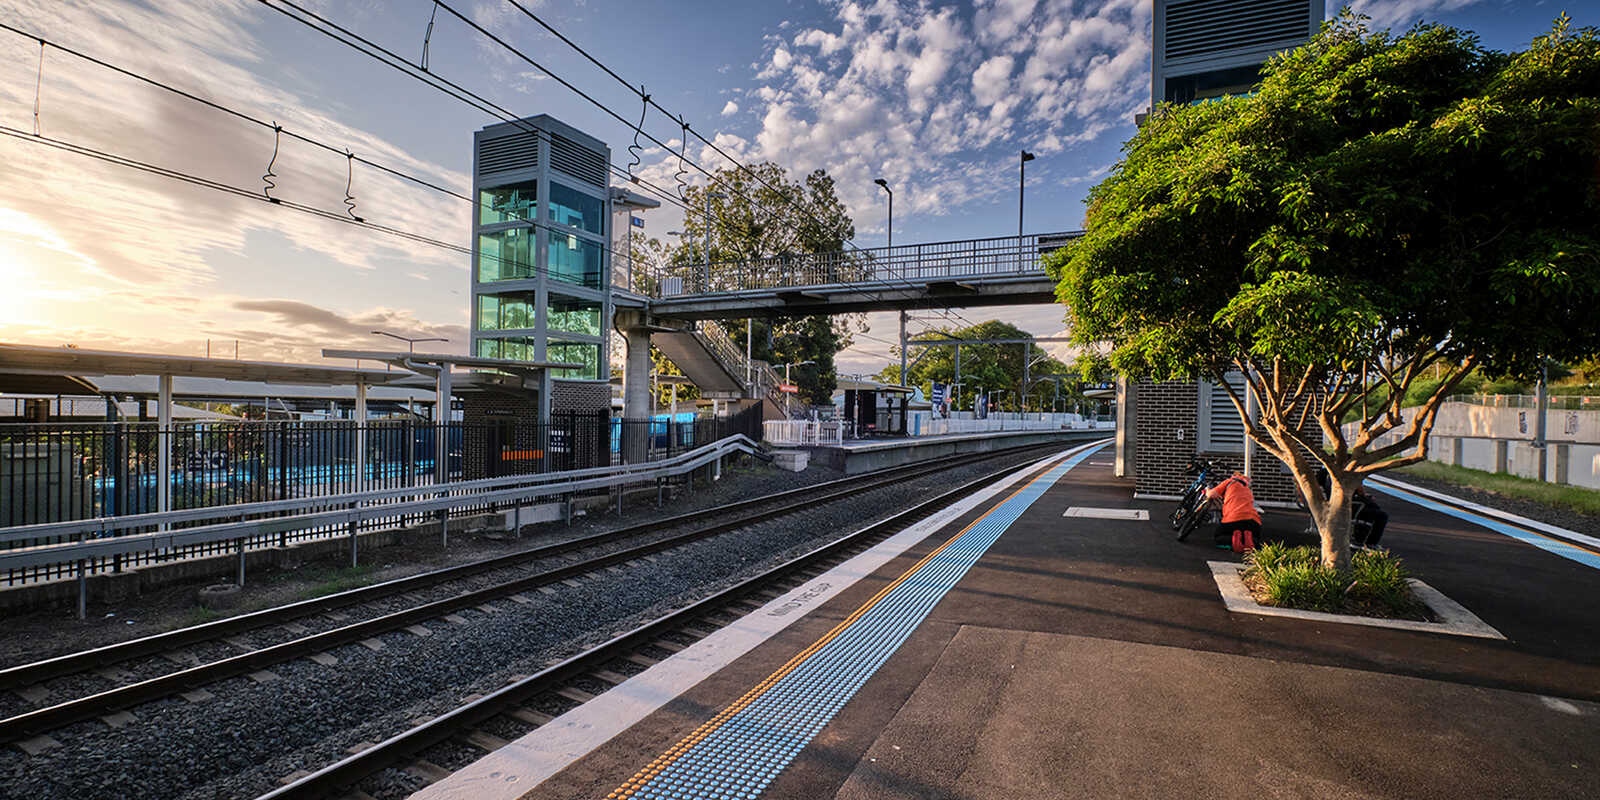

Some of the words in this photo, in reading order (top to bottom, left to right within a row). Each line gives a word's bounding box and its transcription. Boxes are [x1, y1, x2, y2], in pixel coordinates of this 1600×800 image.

[767, 602, 802, 617] MIND
[791, 592, 820, 603] THE
[809, 583, 833, 593] GAP
